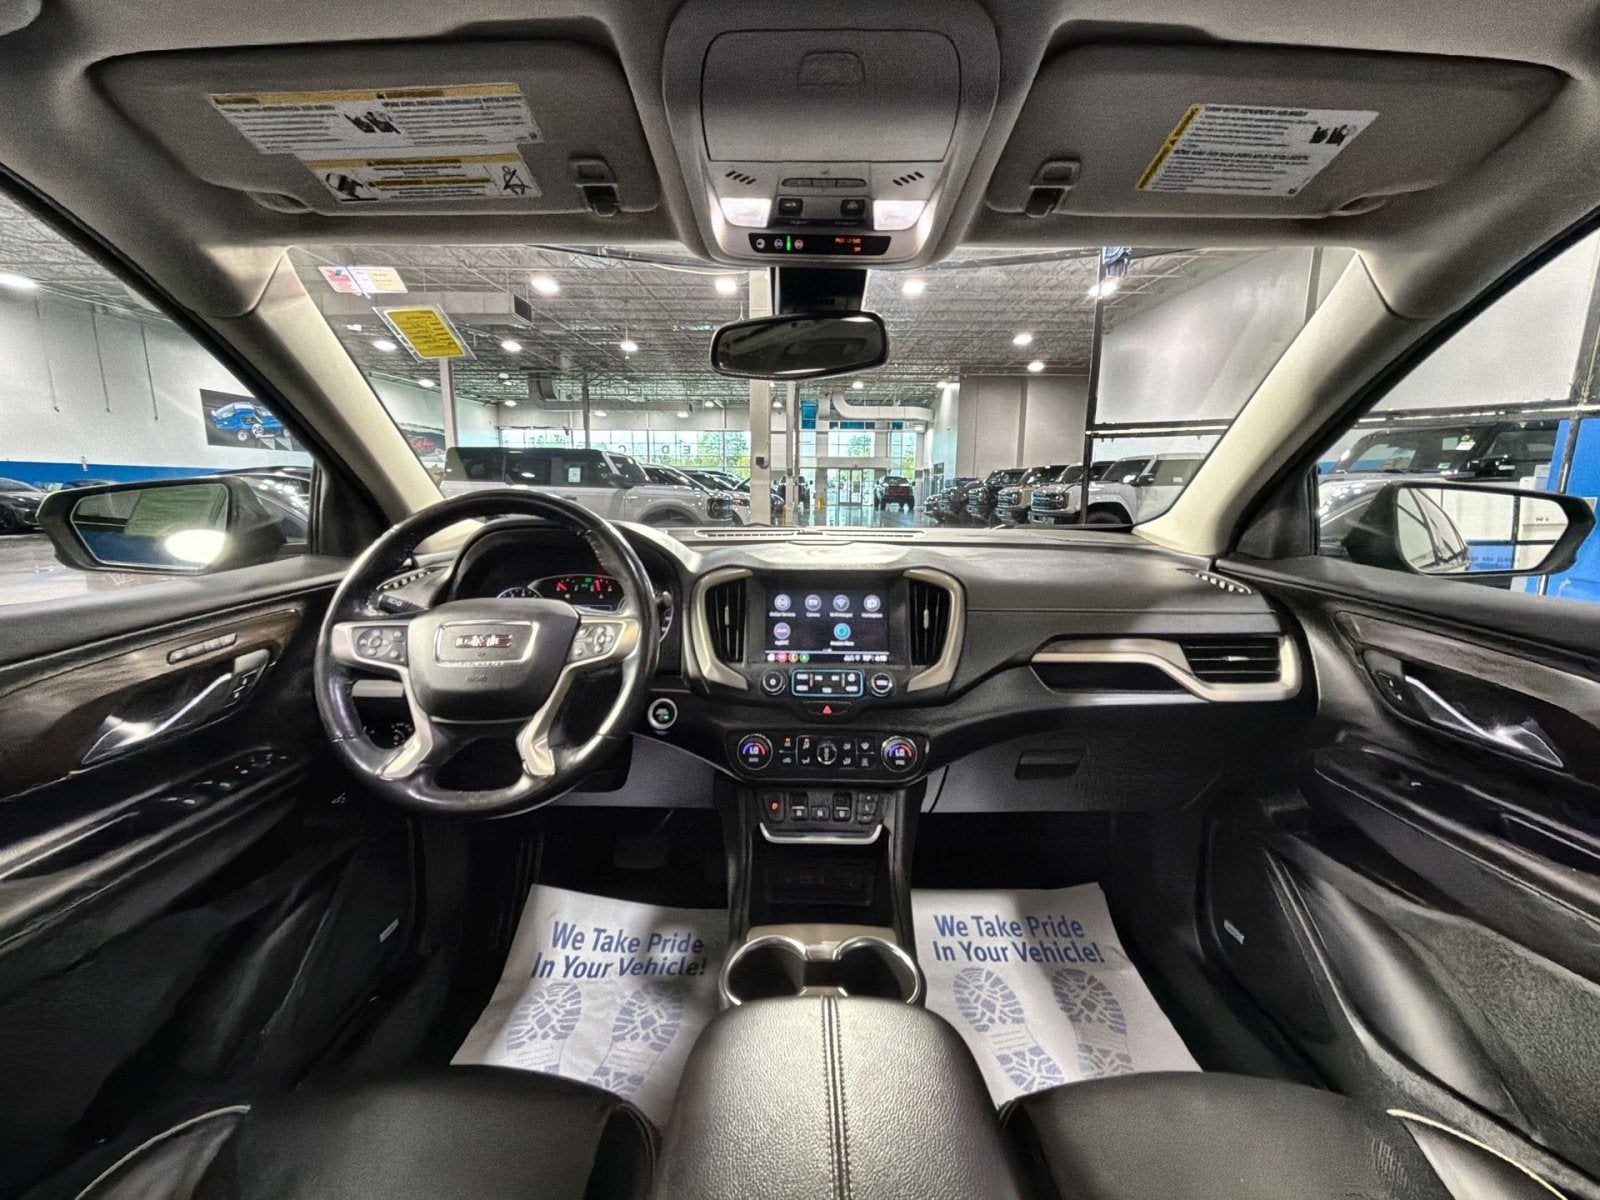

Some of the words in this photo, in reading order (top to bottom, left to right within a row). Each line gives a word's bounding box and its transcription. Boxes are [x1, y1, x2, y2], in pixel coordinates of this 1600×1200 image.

[455, 633, 512, 648] GMC
[551, 921, 585, 950] We
[591, 927, 640, 954] Take
[646, 933, 704, 954] Pride
[934, 915, 968, 937] We
[971, 915, 1023, 938] Take
[1027, 915, 1084, 938] Pride
[932, 941, 956, 961] In
[958, 941, 1010, 962] Your
[1012, 941, 1106, 963] Vehicle!
[531, 952, 554, 978] In
[561, 955, 614, 978] Your
[618, 957, 707, 977] Vehicle!
